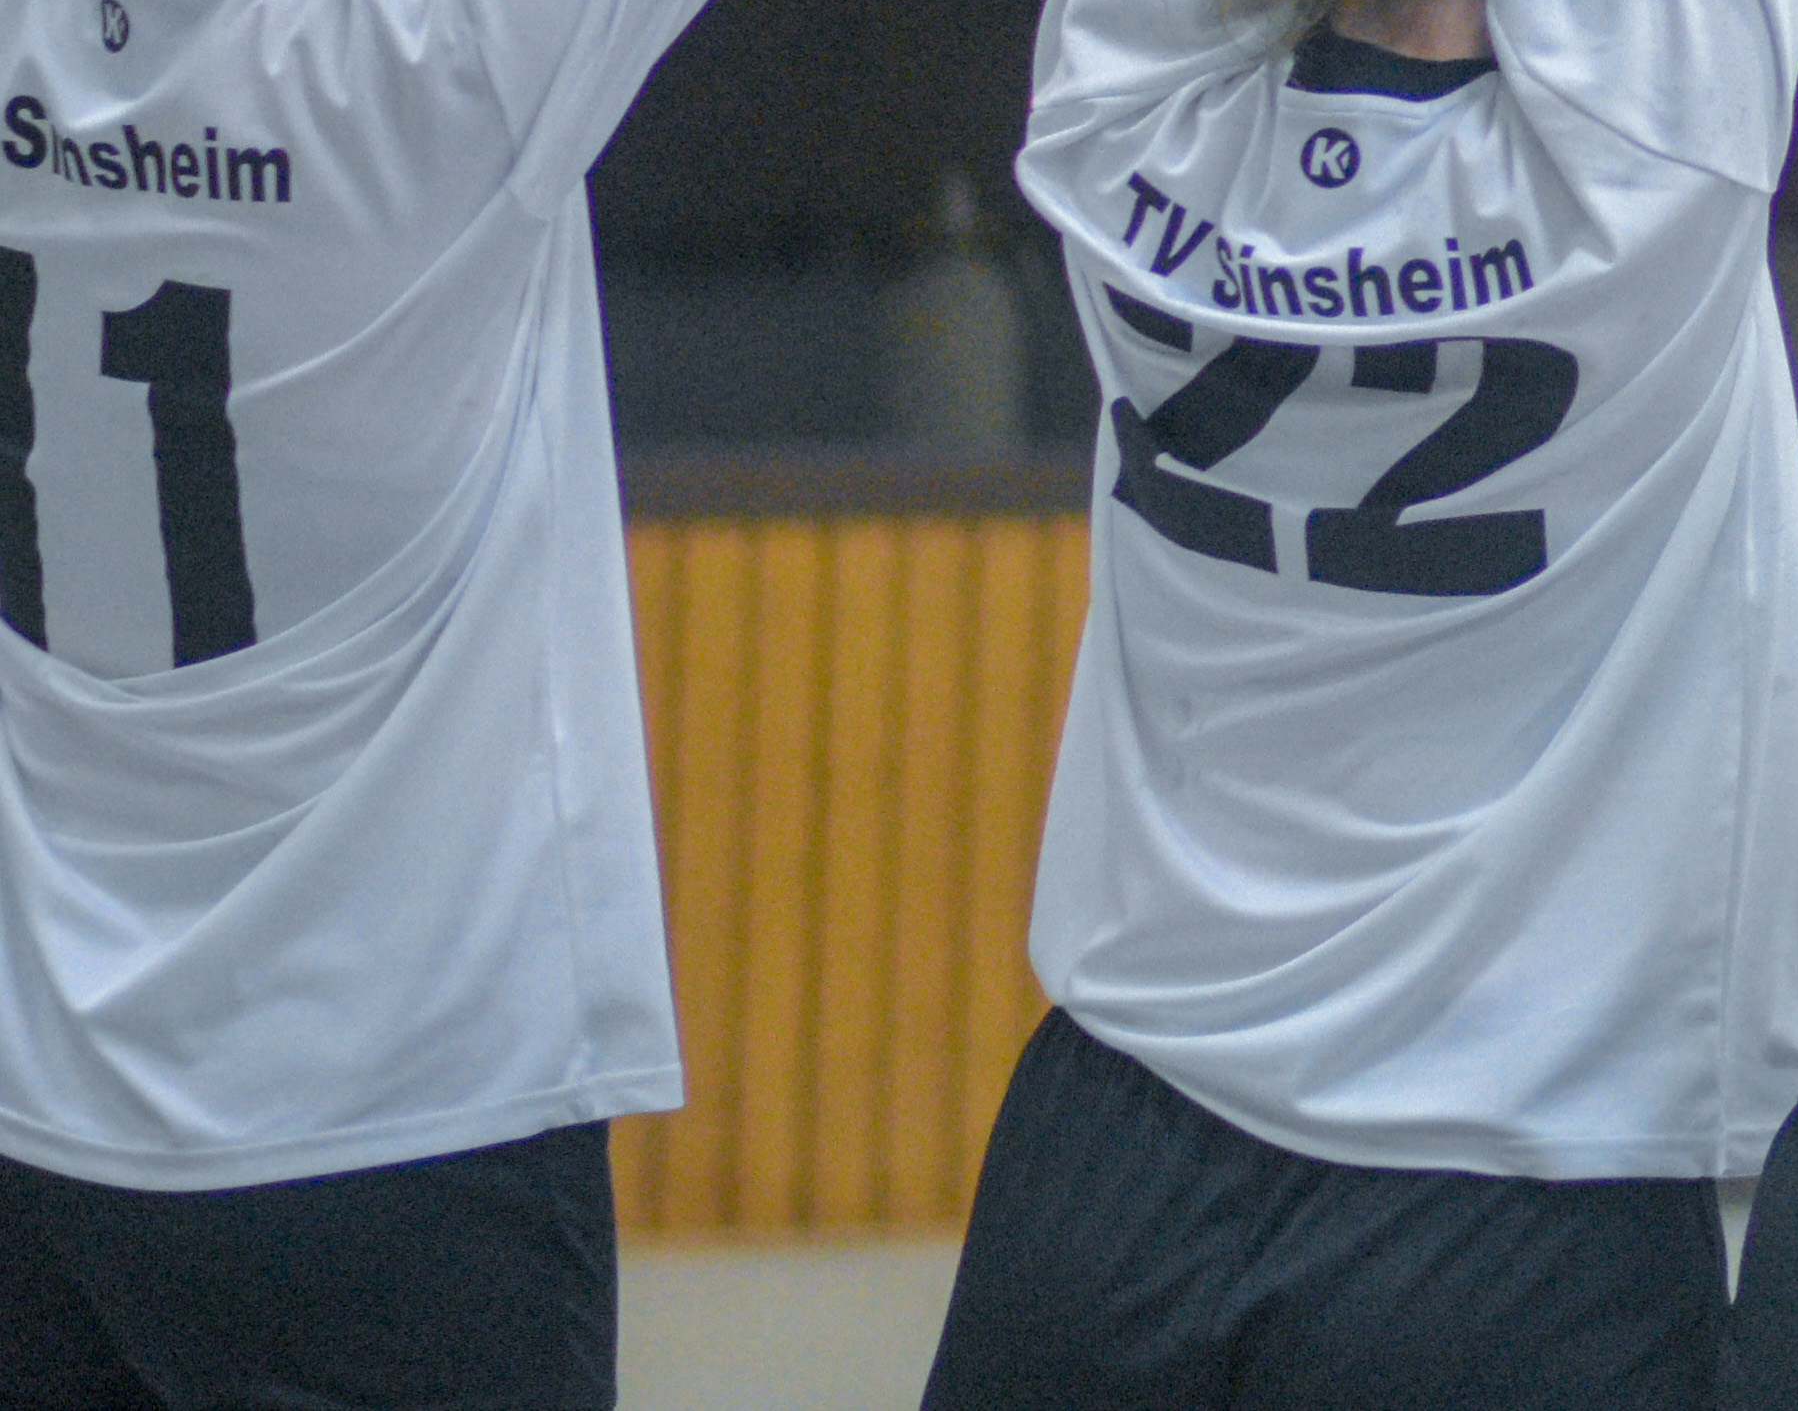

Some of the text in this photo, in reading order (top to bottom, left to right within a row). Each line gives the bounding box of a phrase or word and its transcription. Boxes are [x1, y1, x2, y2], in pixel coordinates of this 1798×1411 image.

[3, 95, 291, 202] Sinsheim
[1121, 172, 1534, 318] TV Sinsheim
[1103, 284, 1580, 598] 22
